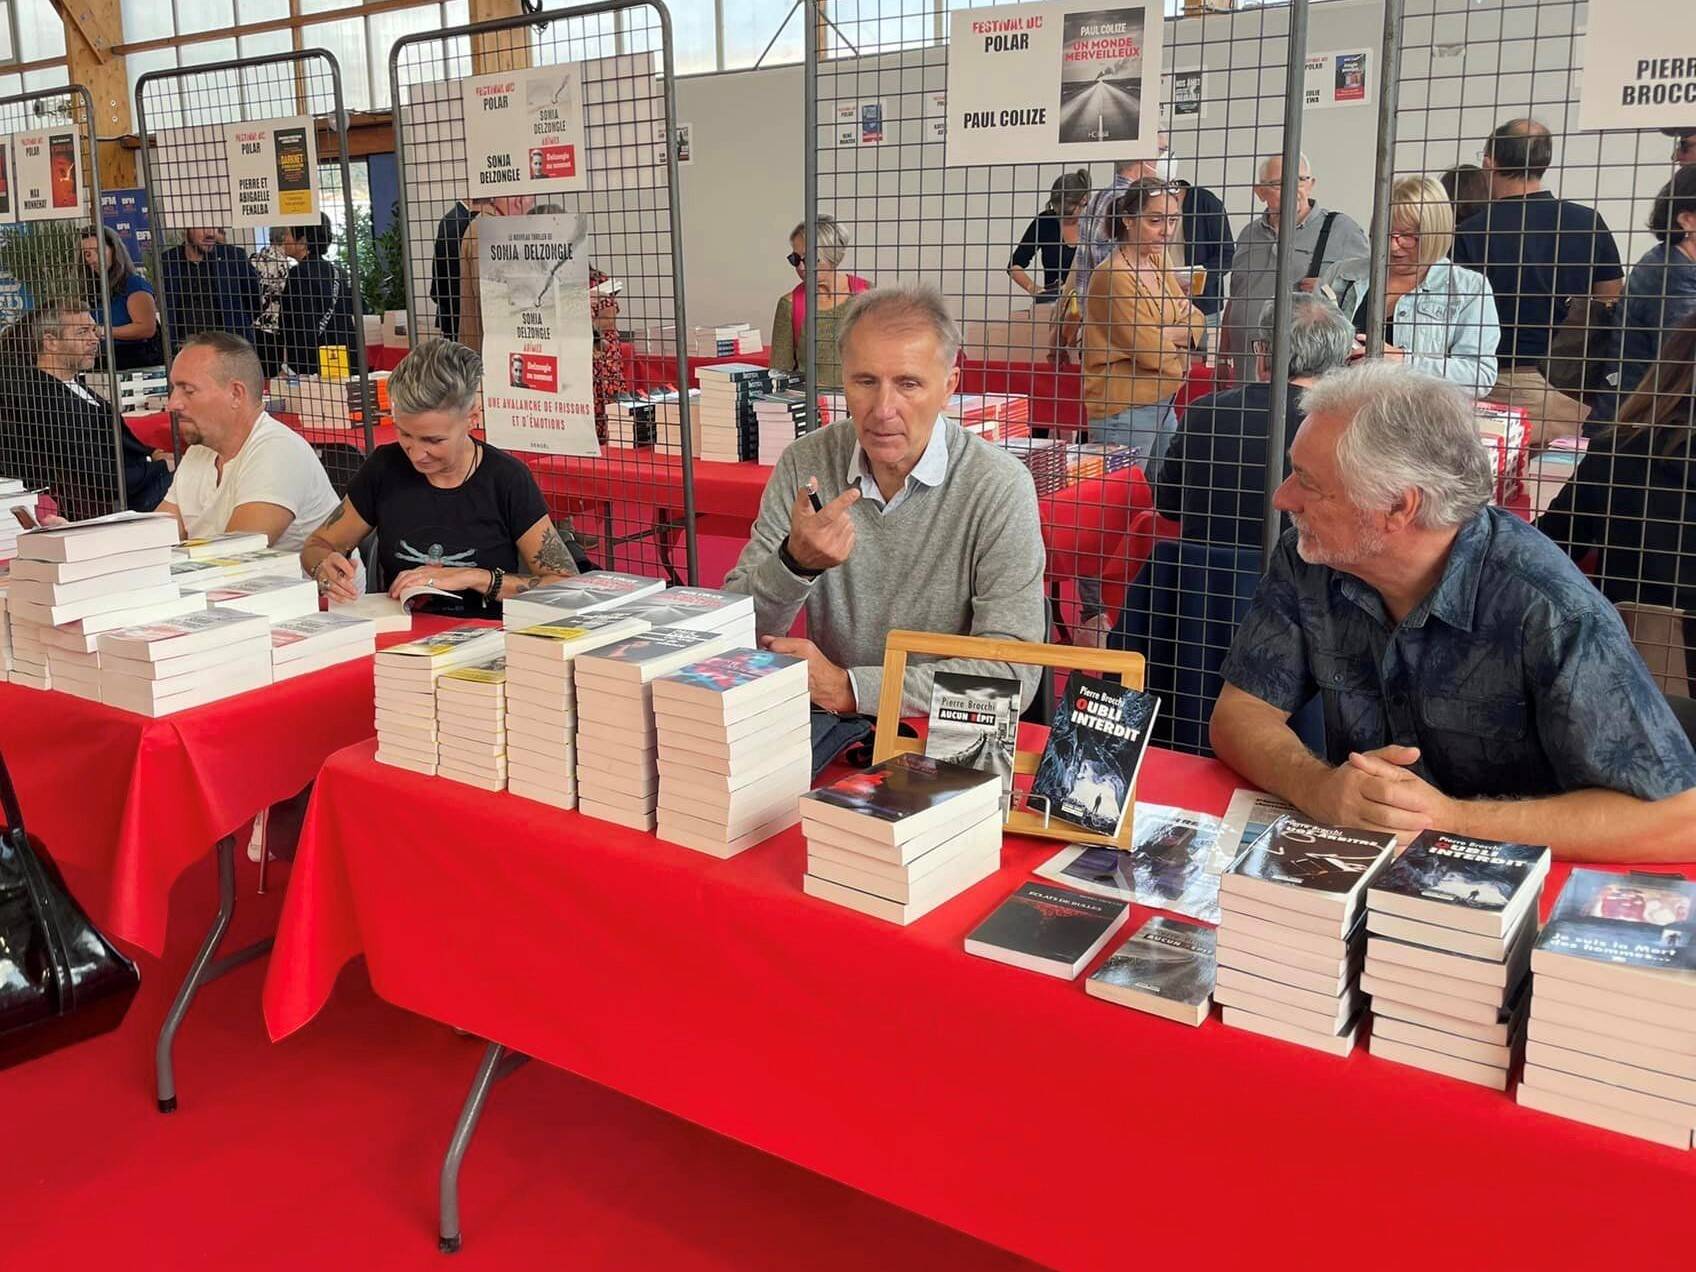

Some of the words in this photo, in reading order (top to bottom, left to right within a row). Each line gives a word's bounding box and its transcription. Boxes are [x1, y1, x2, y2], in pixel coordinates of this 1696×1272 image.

[1081, 26, 1100, 37] PAUL
[1100, 23, 1127, 34] COLIZE
[985, 33, 1029, 52] POLAR
[1073, 41, 1089, 51] UN
[1092, 38, 1133, 49] MONDE
[1065, 48, 1141, 62] MERVEILLEUX
[1622, 83, 1696, 106] BROCC
[484, 95, 509, 111] POLAR
[964, 111, 996, 129] PAUL
[1000, 108, 1046, 127] COLIZE
[533, 120, 567, 135] DELZONGLE
[486, 153, 512, 169] SONJA
[240, 178, 260, 190] PIERRE
[261, 177, 268, 189] ET
[480, 168, 520, 184] DELZONGLE
[242, 203, 269, 216] PENALBA
[490, 244, 519, 261] SONJA
[524, 243, 573, 261] DELZONGLE
[517, 326, 551, 340] DELZONGLE
[488, 397, 501, 409] UNE
[503, 399, 541, 412] AVALANCHE
[543, 400, 553, 413] DE
[555, 401, 590, 416] FRISSONS
[512, 415, 520, 427] ET
[1080, 685, 1100, 700] Pierre
[942, 696, 964, 708] Pierre
[967, 700, 995, 711] Brocchi
[1076, 697, 1122, 722] OUBLI
[940, 709, 968, 721] AUCUN
[1071, 710, 1140, 743] INTERDIT
[1439, 836, 1467, 846] Pierre
[1428, 846, 1528, 867] INTERDIT
[1434, 841, 1500, 857] OUBLI
[1145, 934, 1181, 947] AUCUN
[1549, 939, 1578, 949] des
[1552, 932, 1569, 941] Je
[1634, 944, 1676, 957] Mort
